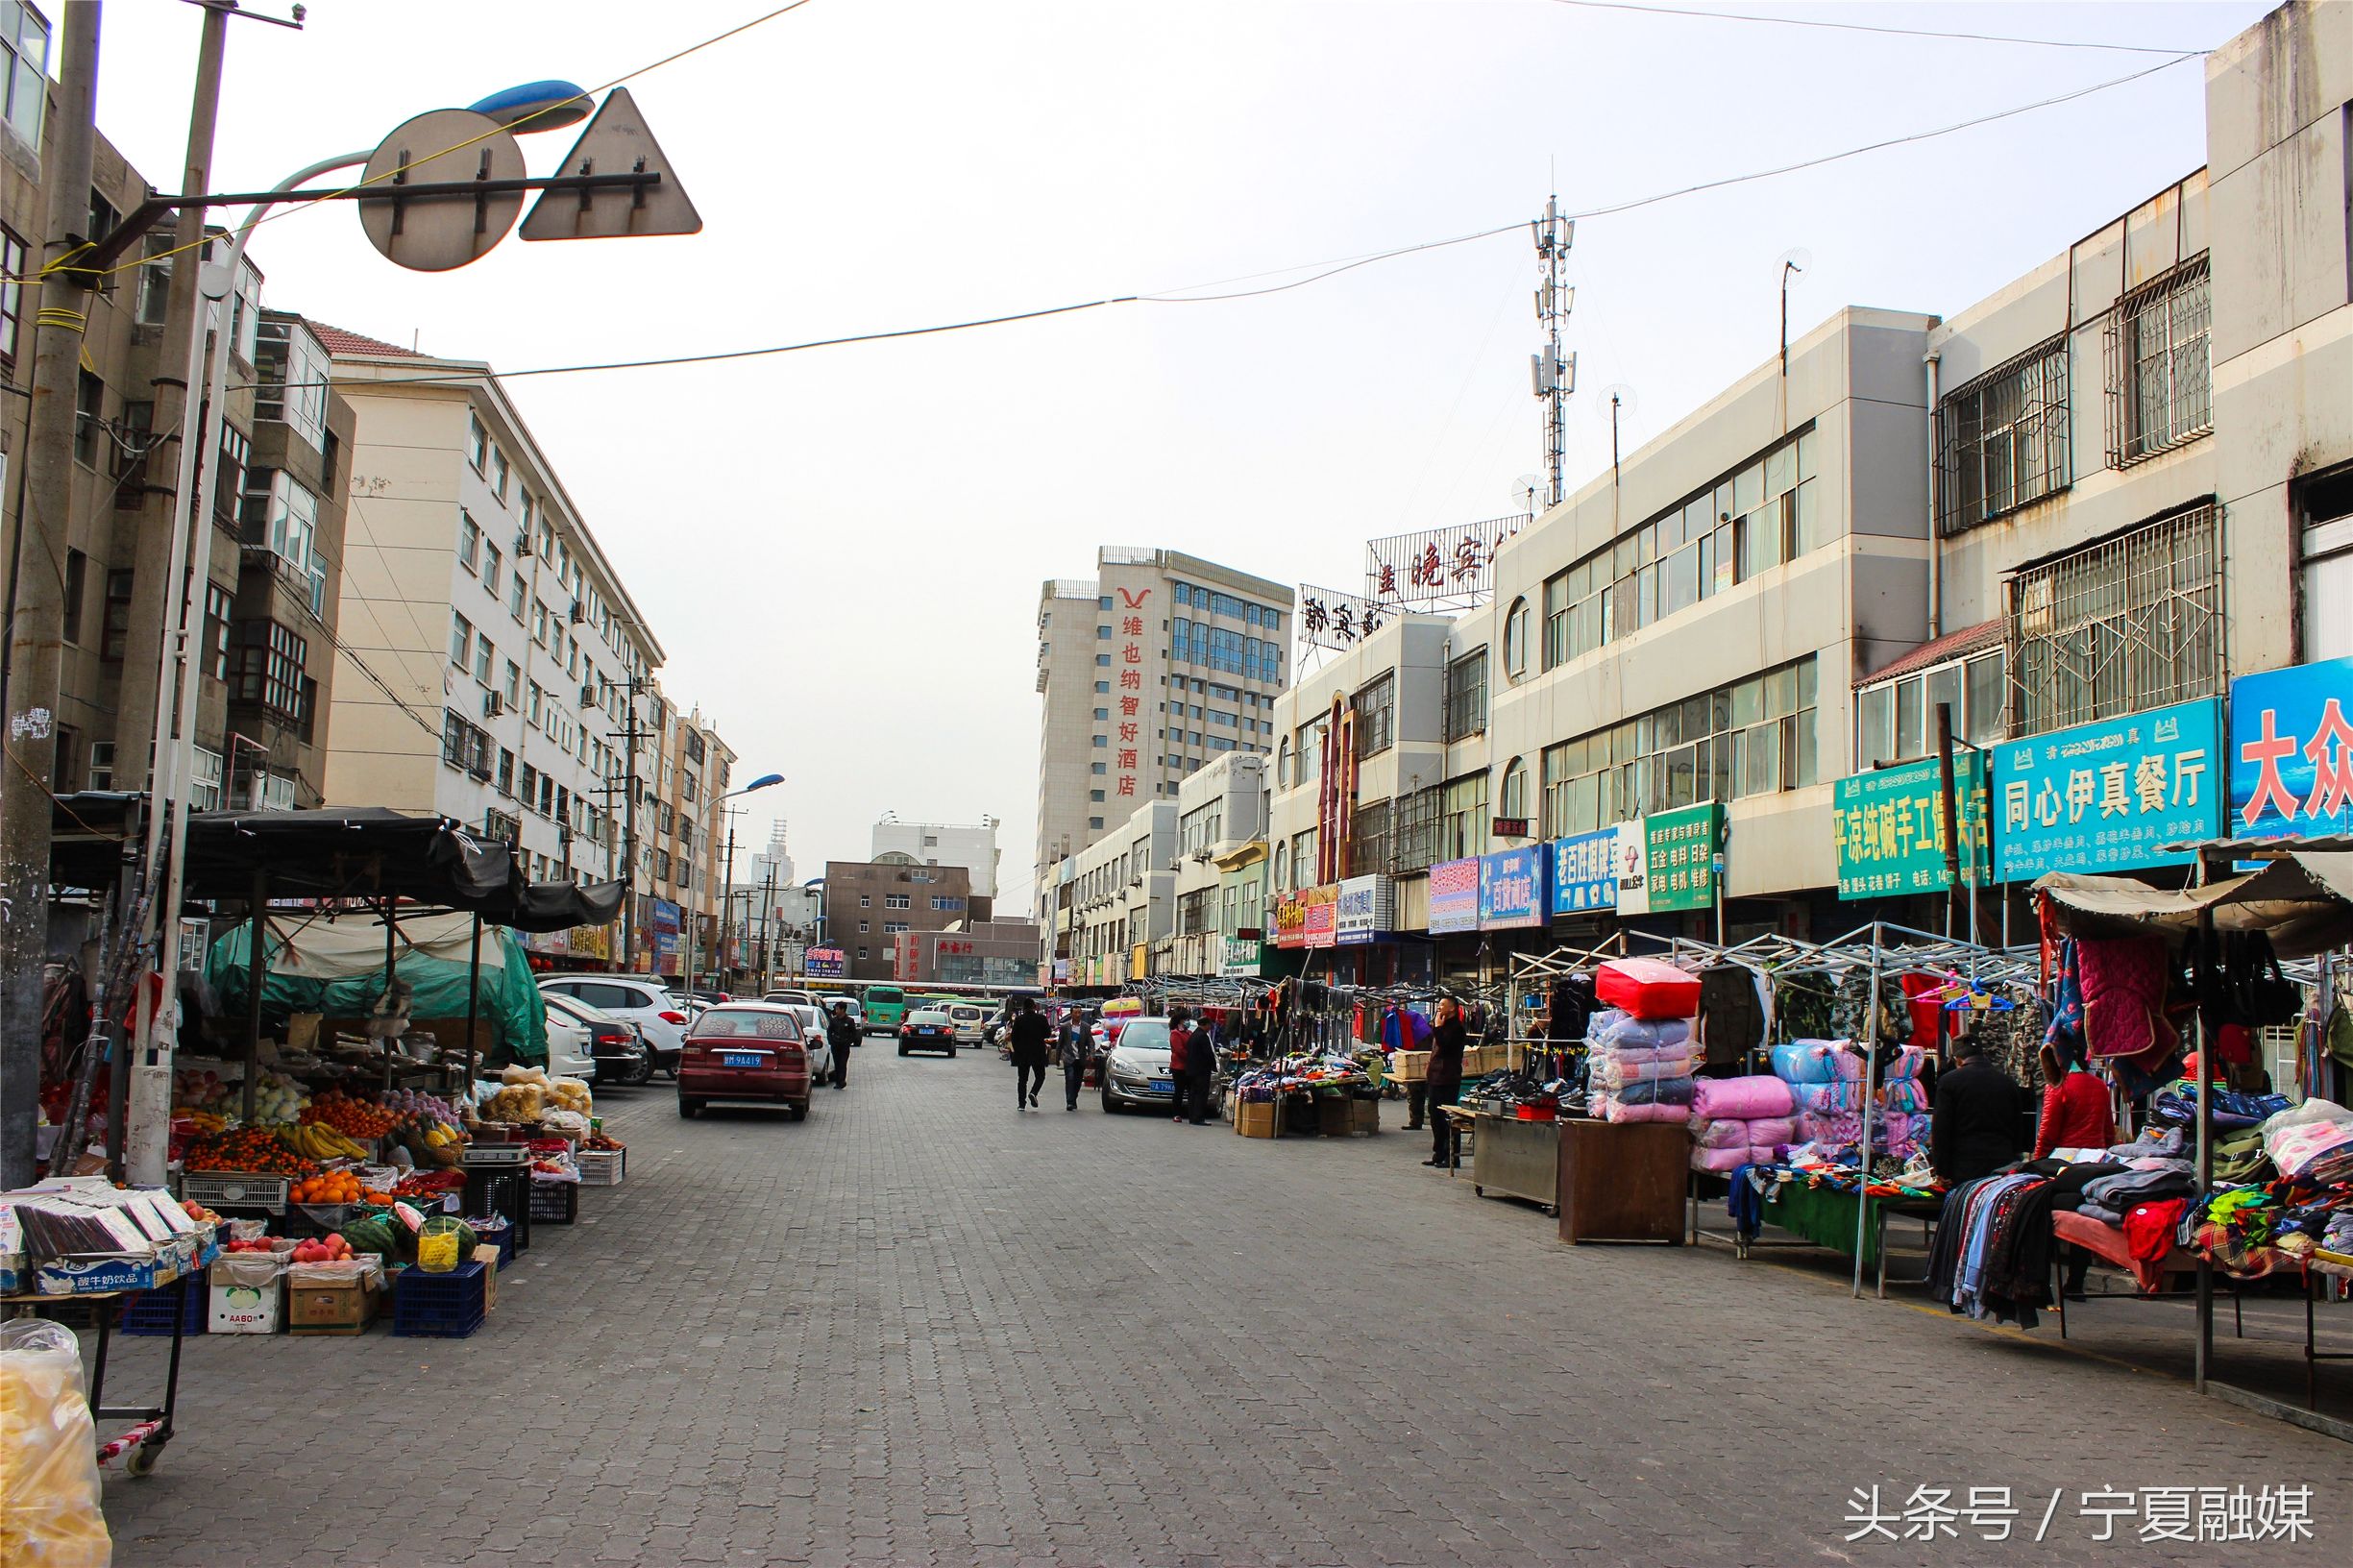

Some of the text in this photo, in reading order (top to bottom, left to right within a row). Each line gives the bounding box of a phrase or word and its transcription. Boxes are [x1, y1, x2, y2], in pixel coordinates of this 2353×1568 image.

[1116, 616, 1143, 796] 维也纳智好酒店
[2127, 727, 2141, 745] 真
[2241, 698, 2353, 828] 大众
[2004, 748, 2206, 835] 同心伊真餐厅
[1651, 821, 1708, 845] 插座专家与领导者
[1651, 843, 1708, 870] 五金 电料 日杂
[1651, 868, 1708, 894] 家电 电机 维修
[77, 1273, 138, 1287] 酸牛奶饮品
[230, 1314, 253, 1323] AA60
